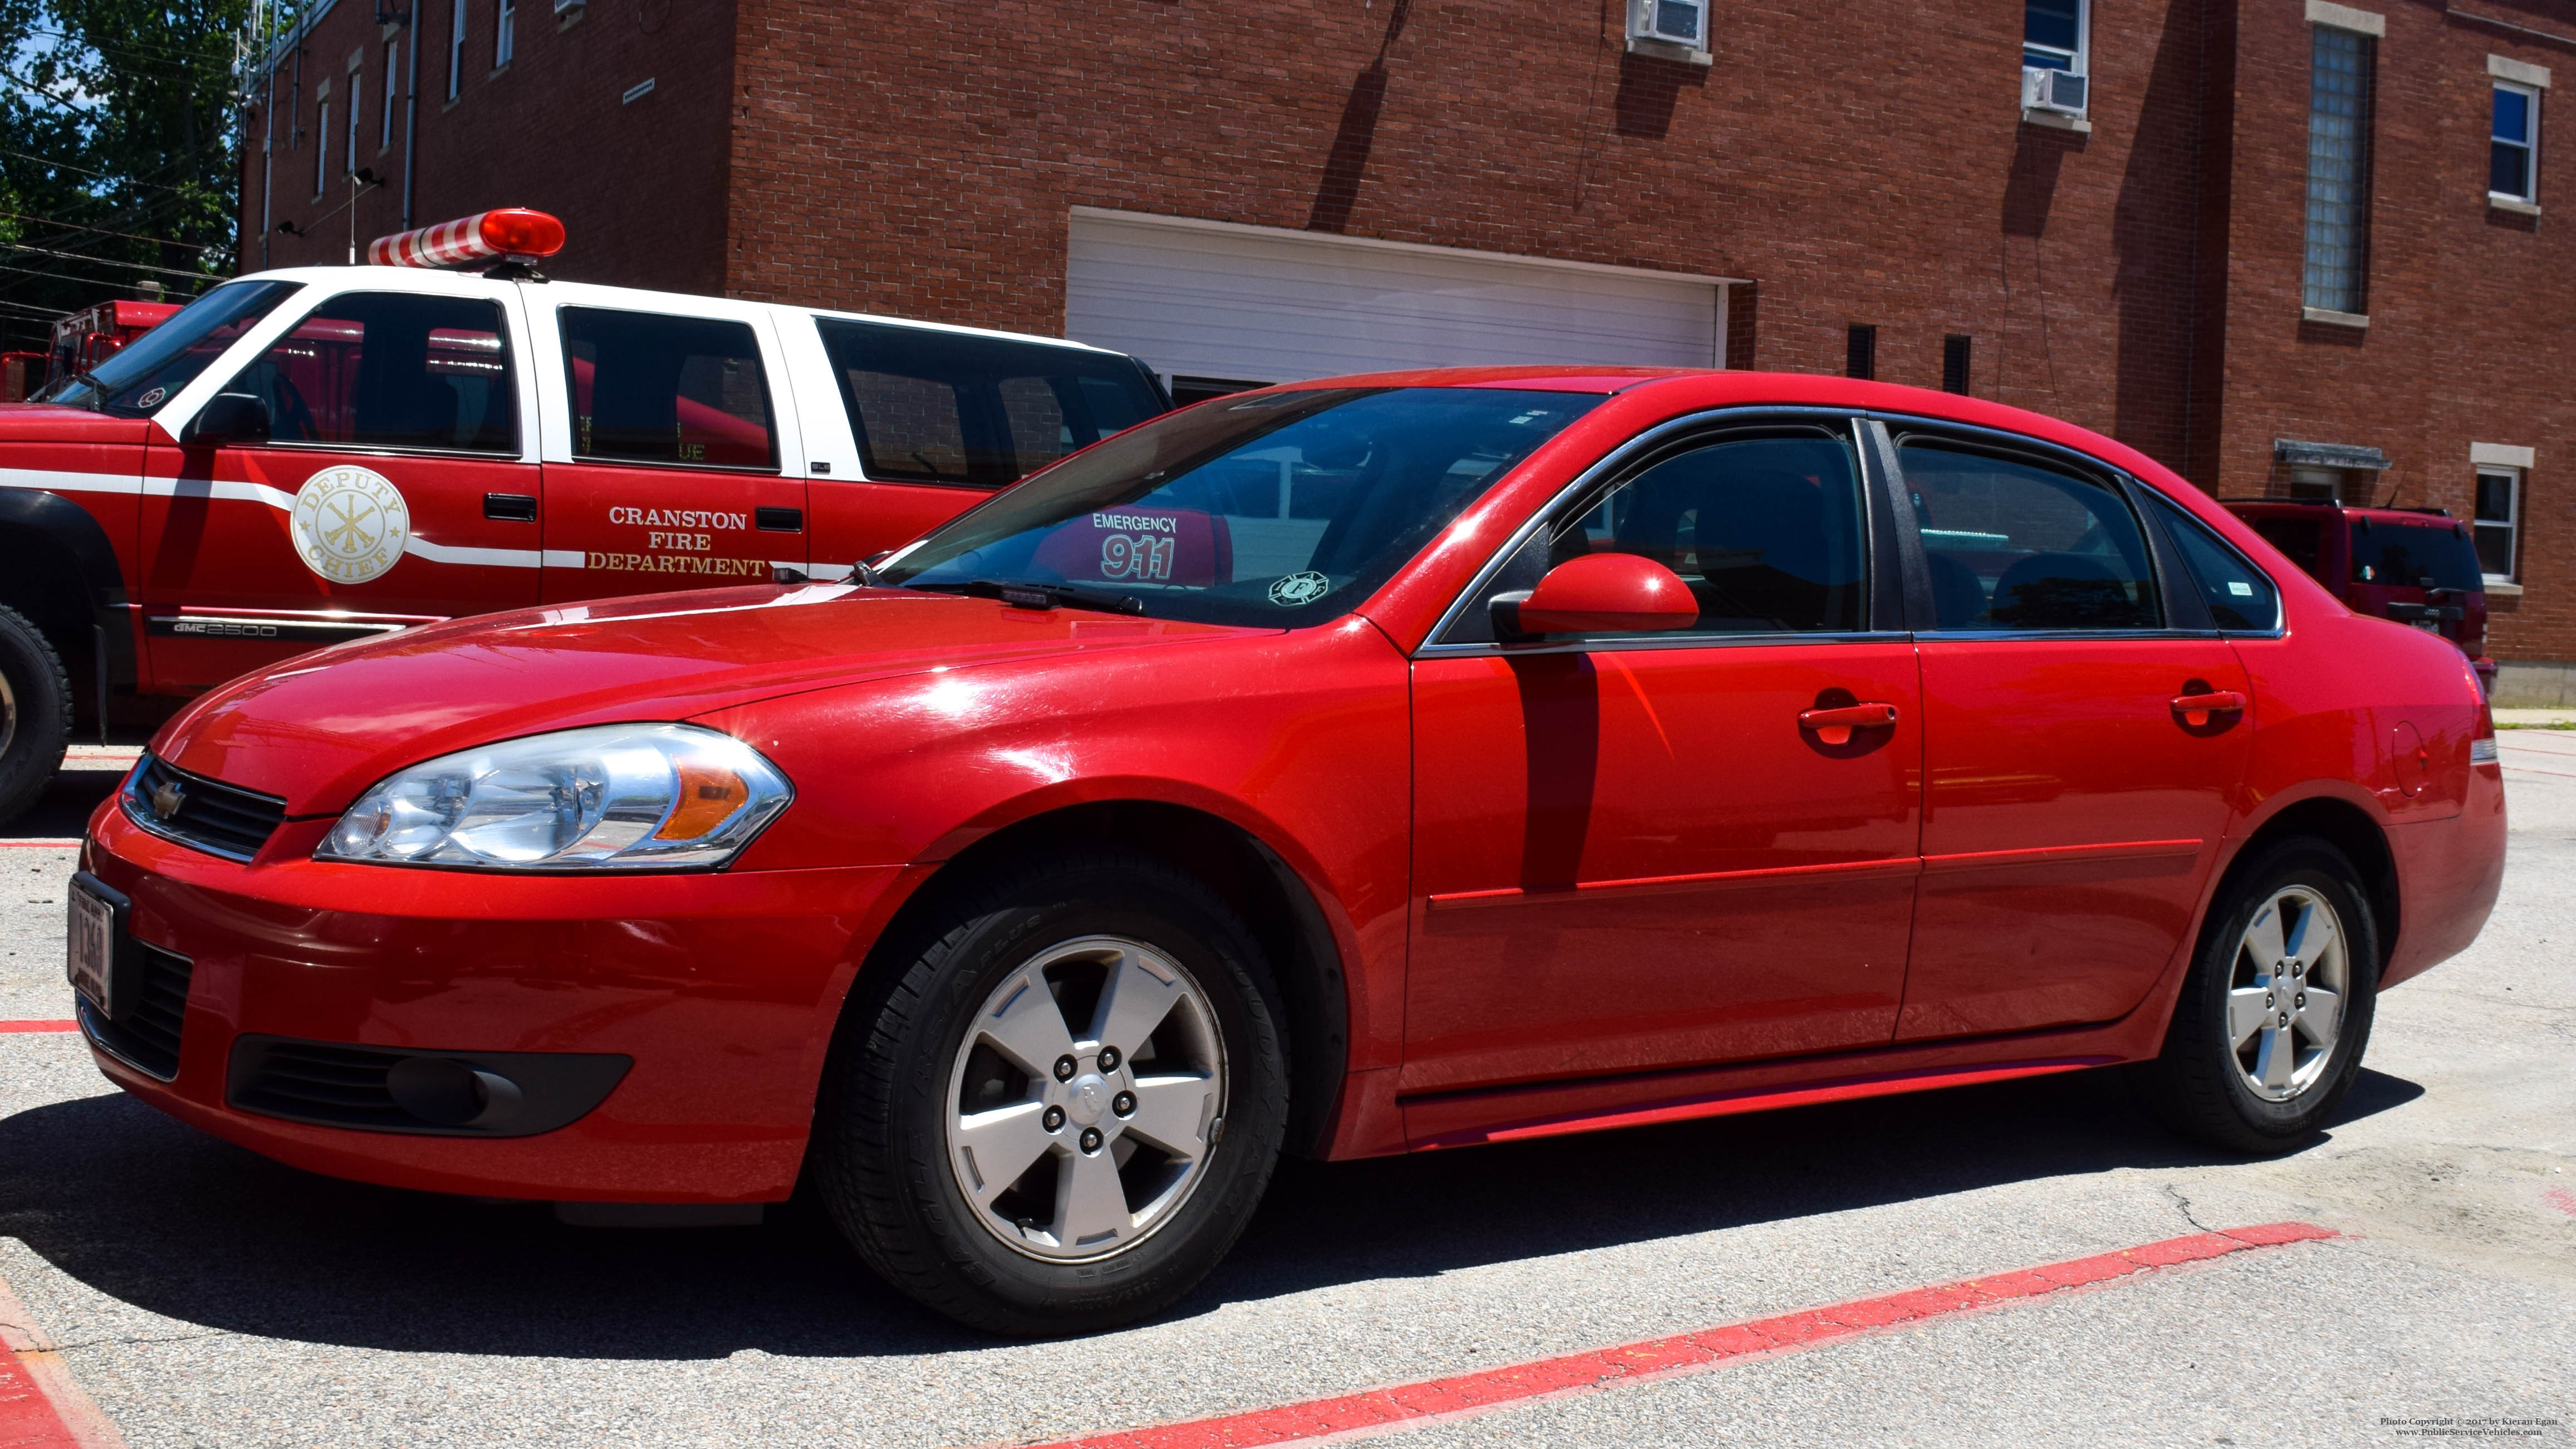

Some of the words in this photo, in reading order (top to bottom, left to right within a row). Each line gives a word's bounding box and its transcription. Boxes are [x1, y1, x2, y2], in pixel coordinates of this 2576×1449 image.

[301, 472, 401, 513] DEPUTY
[609, 506, 747, 530] CRANSTON
[1093, 513, 1176, 533] EMERGENCY
[648, 531, 711, 551] FIRE
[308, 545, 388, 577] CHIEF
[588, 552, 765, 576] DEPARTMENT
[174, 623, 207, 633] GMC
[207, 624, 277, 637] 2500
